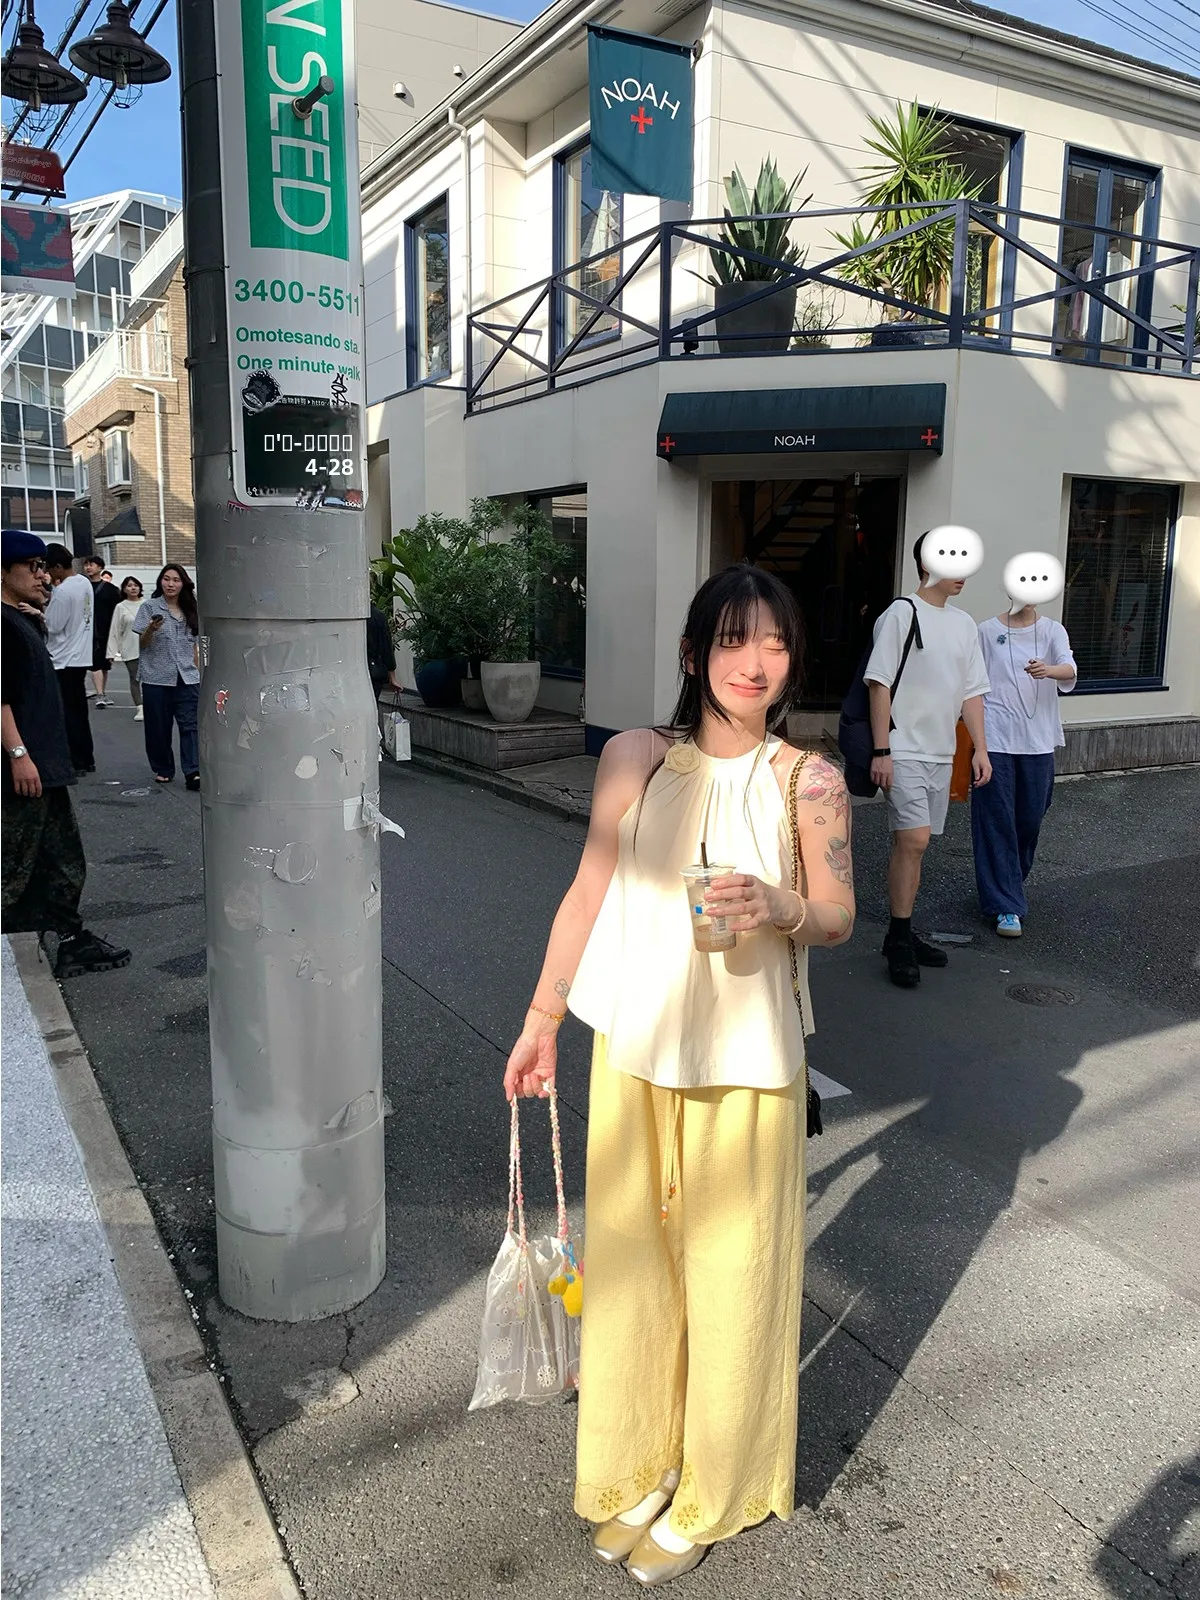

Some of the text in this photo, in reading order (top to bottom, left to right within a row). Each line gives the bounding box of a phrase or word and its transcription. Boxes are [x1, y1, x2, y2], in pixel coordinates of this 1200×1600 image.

[600, 78, 681, 120] NOAH
[267, 45, 332, 235] SEED
[234, 279, 360, 317] 3400-5511
[236, 327, 360, 355] Omotesando sta.
[237, 354, 361, 381] One minute walk
[774, 434, 816, 447] NOAH
[305, 458, 354, 476] 4-28
